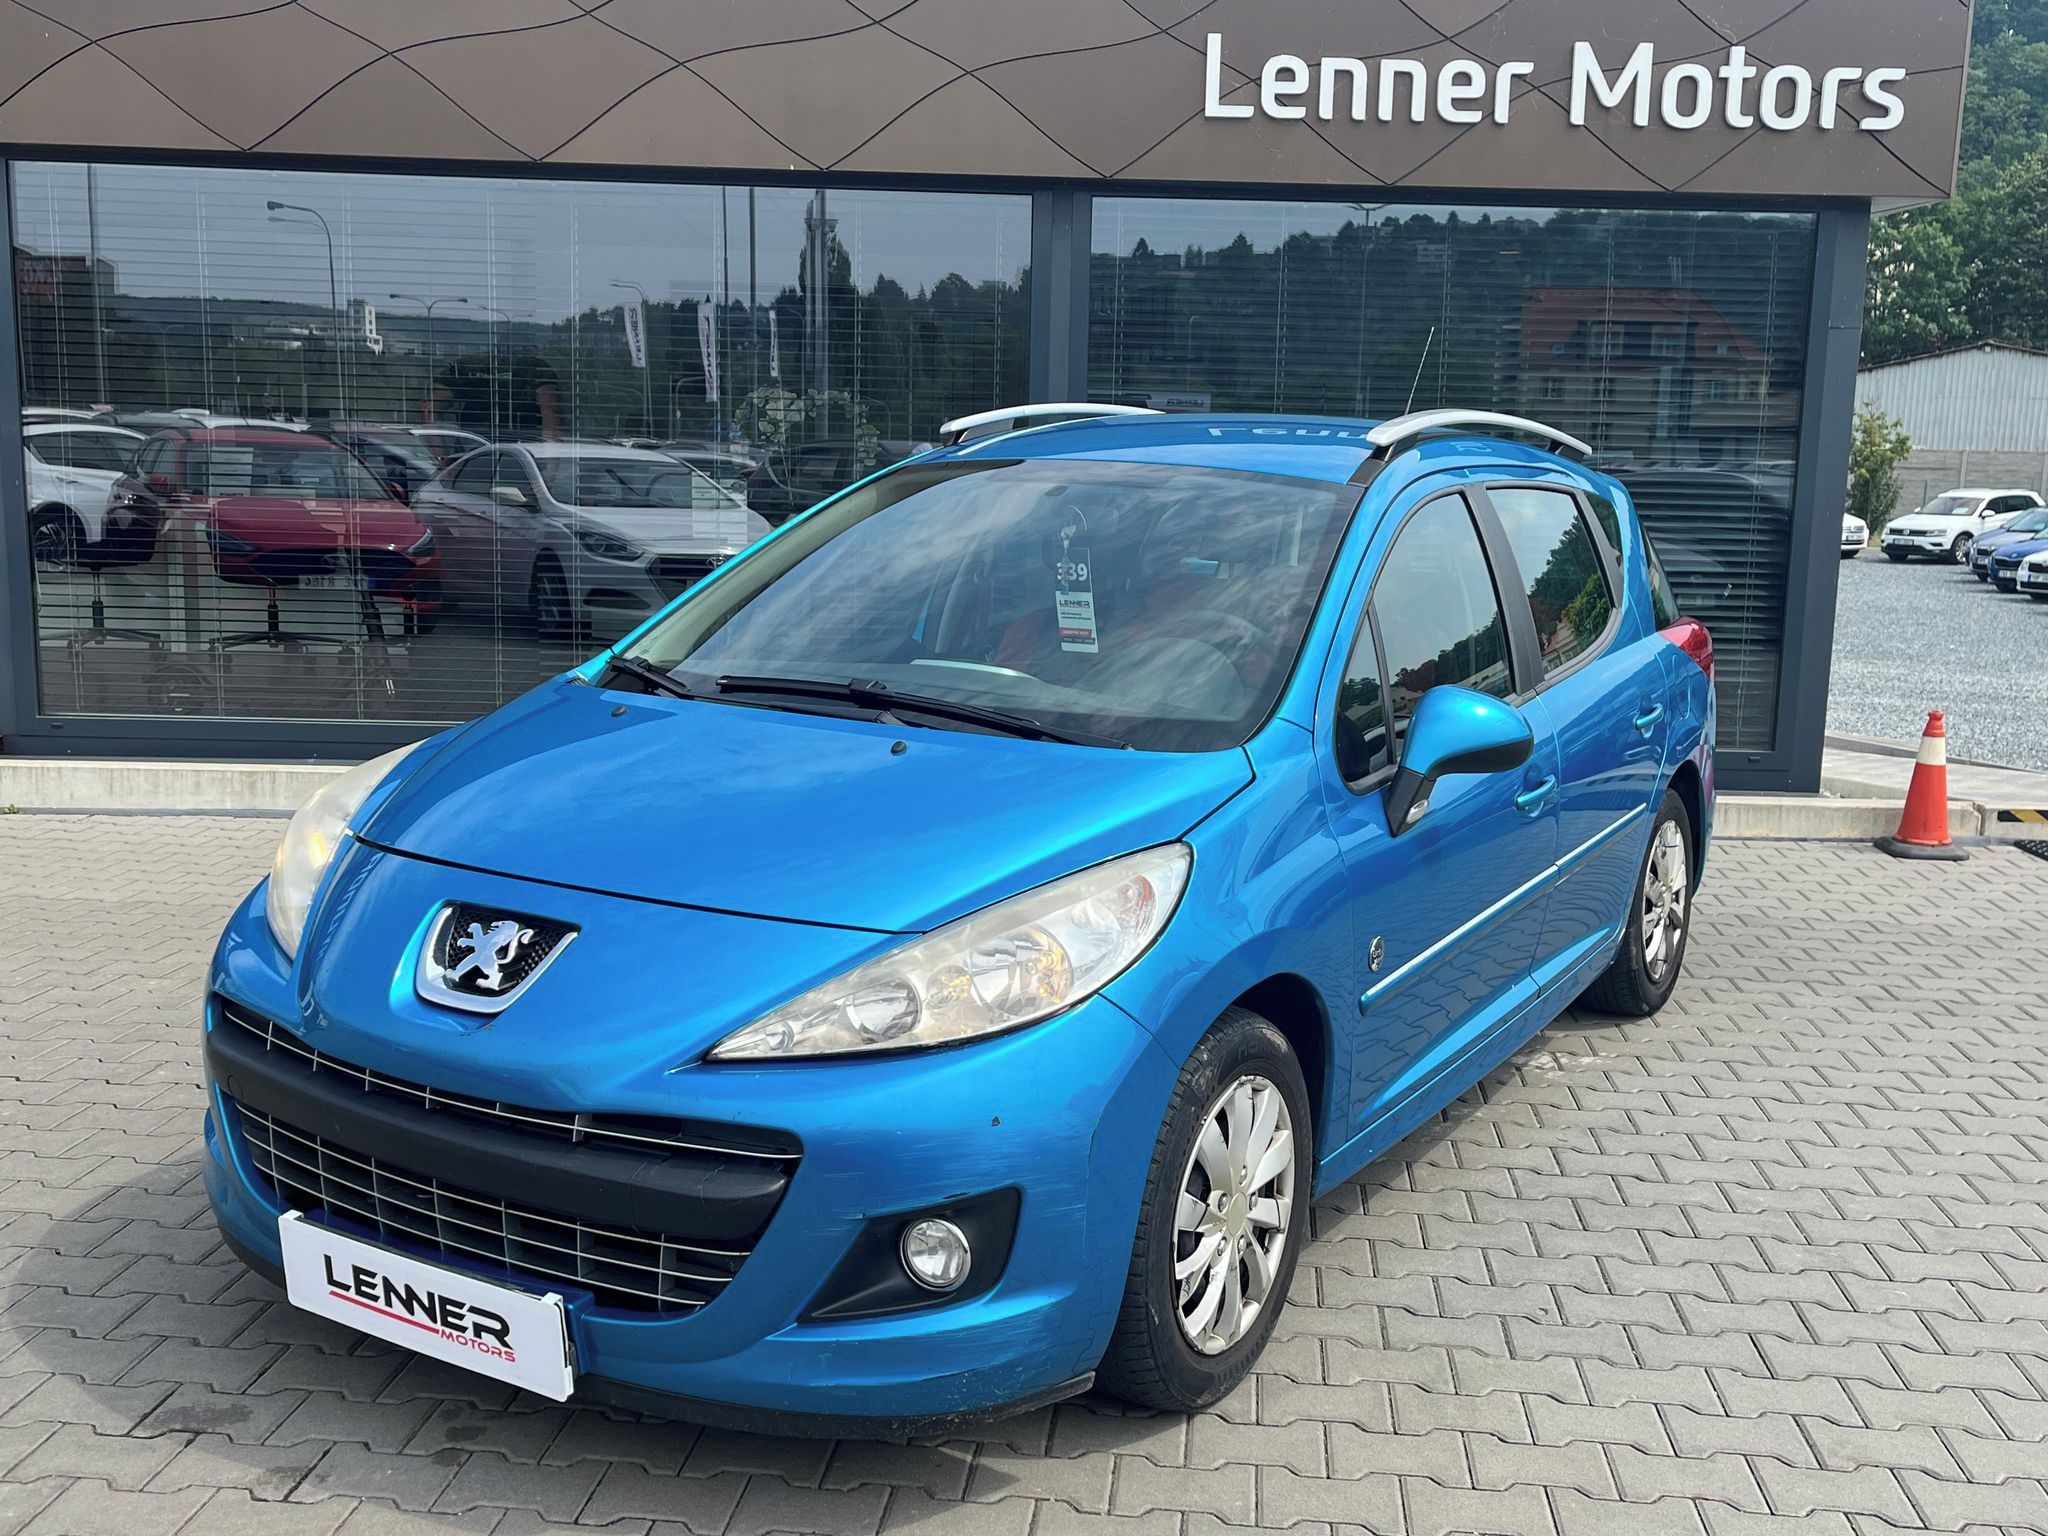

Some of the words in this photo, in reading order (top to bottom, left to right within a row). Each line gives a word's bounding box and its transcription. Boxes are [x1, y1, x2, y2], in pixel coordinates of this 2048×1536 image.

[1204, 33, 1535, 125] Lenner
[1568, 40, 1908, 132] Motors
[1059, 599, 1090, 608] LENNER
[323, 1253, 514, 1350] LENNER
[440, 1329, 516, 1363] MOTORS
